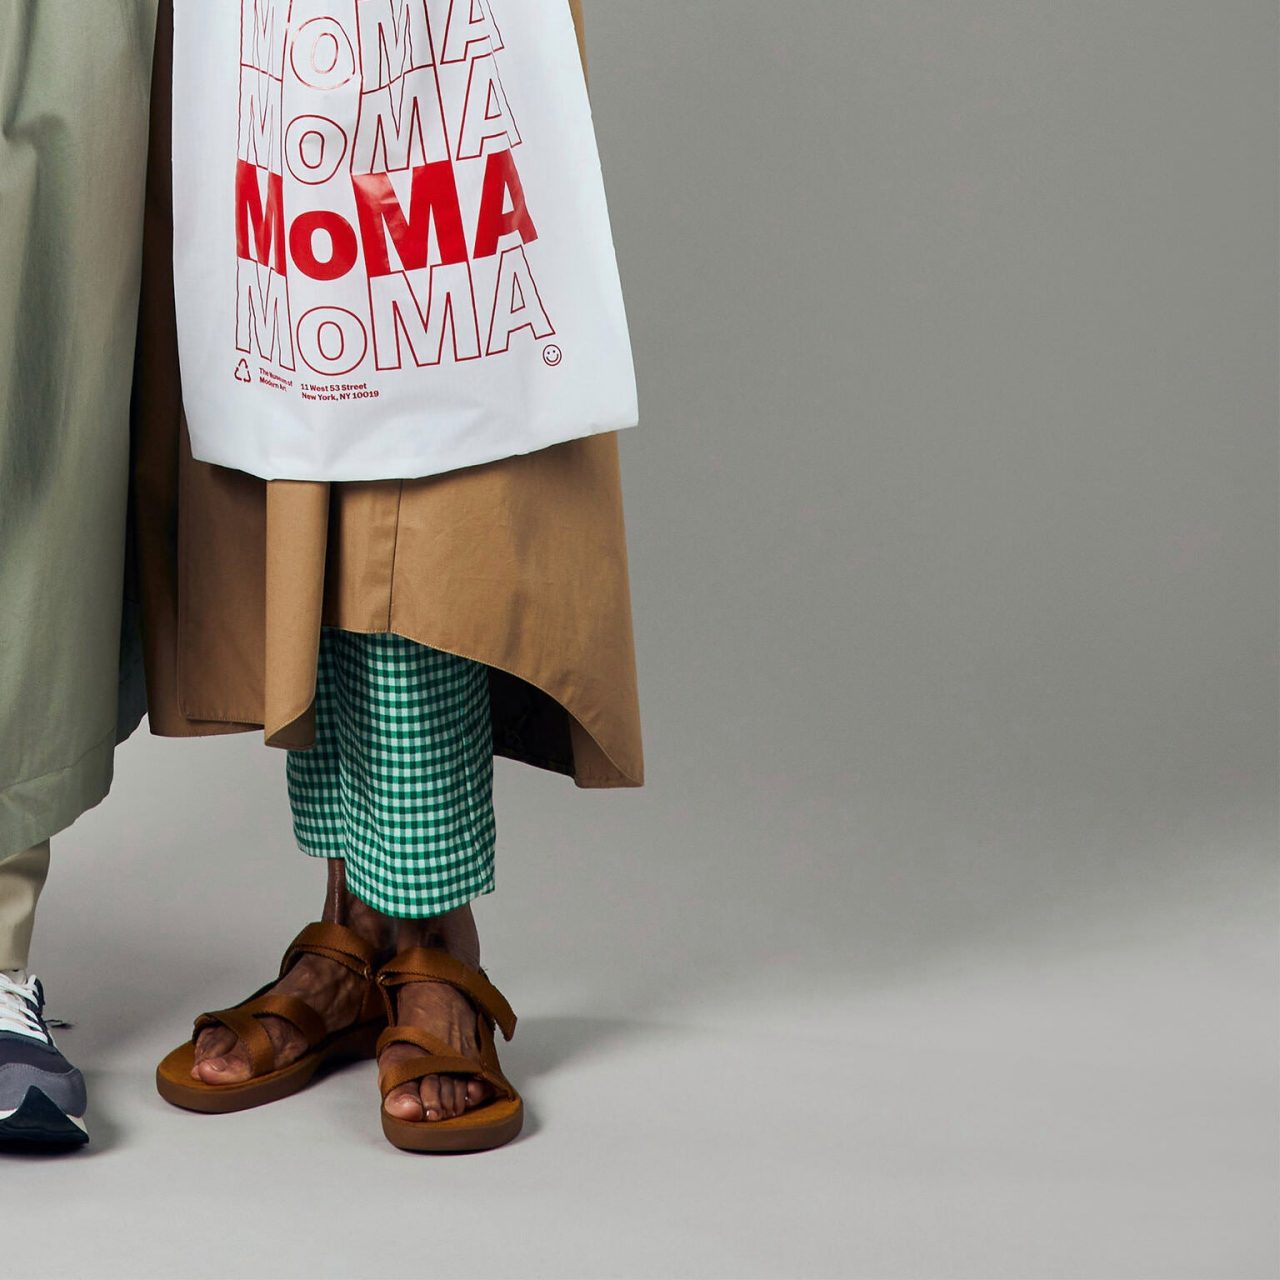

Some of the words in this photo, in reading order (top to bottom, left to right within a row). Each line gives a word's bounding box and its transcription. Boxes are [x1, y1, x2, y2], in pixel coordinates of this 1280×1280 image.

[237, 52, 523, 185] MoMA
[235, 148, 539, 282] MoMA
[235, 244, 556, 377] MoMA
[300, 383, 309, 391] 11
[310, 384, 329, 392] West
[330, 384, 340, 392] 53
[341, 382, 367, 392] Street
[302, 391, 316, 401] New
[317, 392, 339, 402] York,
[339, 392, 351, 401] NY
[352, 390, 380, 400] 10019
